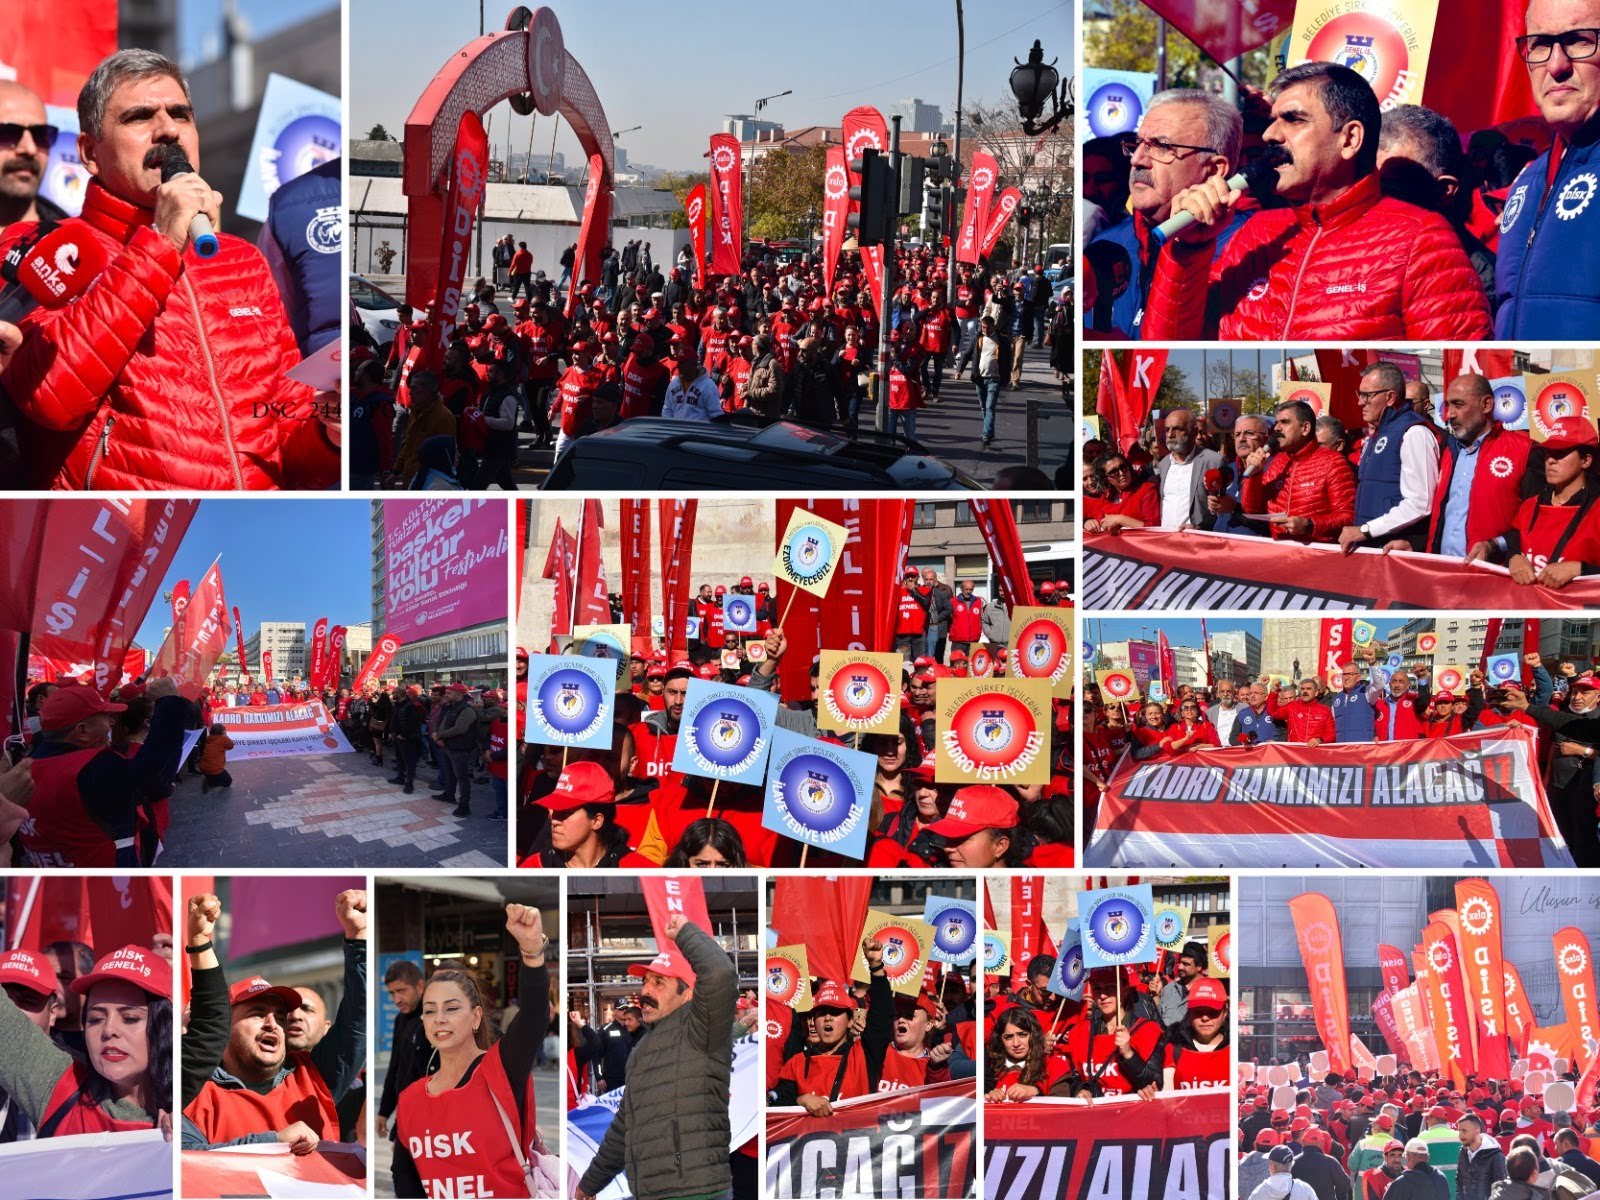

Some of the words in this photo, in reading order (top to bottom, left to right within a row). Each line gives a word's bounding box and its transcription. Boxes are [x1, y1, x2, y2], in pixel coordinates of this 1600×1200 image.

[1303, 5, 1341, 42] BELEDİYE
[1565, 186, 1588, 200] DİSK
[34, 256, 67, 295] anka
[438, 205, 471, 350] DİSK
[1326, 280, 1367, 294] GENEL-İŞ
[389, 529, 465, 593] kültür
[782, 544, 832, 586] EZDİRMEYECEĞİZ!
[389, 567, 438, 613] yolu
[1011, 649, 1026, 678] KADR
[213, 713, 241, 724] KADRO
[823, 689, 846, 723] KADRO
[846, 693, 897, 730] İSTİYORUZ!
[944, 689, 975, 718] BELEDİYE
[976, 684, 1005, 695] ŞİRKET
[1007, 685, 1042, 718] İŞÇİLERİNE
[532, 699, 546, 727] İLAVE
[543, 720, 575, 744] TEDİYE
[575, 703, 609, 743] HAKKIMIZ
[684, 725, 700, 756] İLAVE
[693, 752, 727, 777] TEDİYE
[728, 736, 767, 777] HAKKIMIZ
[834, 755, 851, 772] KAMU
[942, 730, 975, 774] KADRO
[975, 730, 1045, 781] İSTİYORUZ!
[1122, 765, 1224, 801] KADRO
[1226, 766, 1364, 805] HAKKIMIZI
[772, 780, 788, 813] İLAVE
[782, 811, 819, 843] TEDİYE
[821, 803, 864, 844] HAKKIMIZ
[10, 951, 35, 965] DİSK
[113, 948, 145, 963] DİSK
[1083, 929, 1100, 953] İLAVE
[1098, 950, 1126, 963] TEDİYE
[1126, 922, 1151, 960] HAKKIMIZ
[2, 961, 40, 977] GENEL-İŞ
[101, 960, 152, 978] GENEL-İŞ
[409, 1128, 476, 1160] DİSK
[422, 1174, 494, 1199] ENEL
